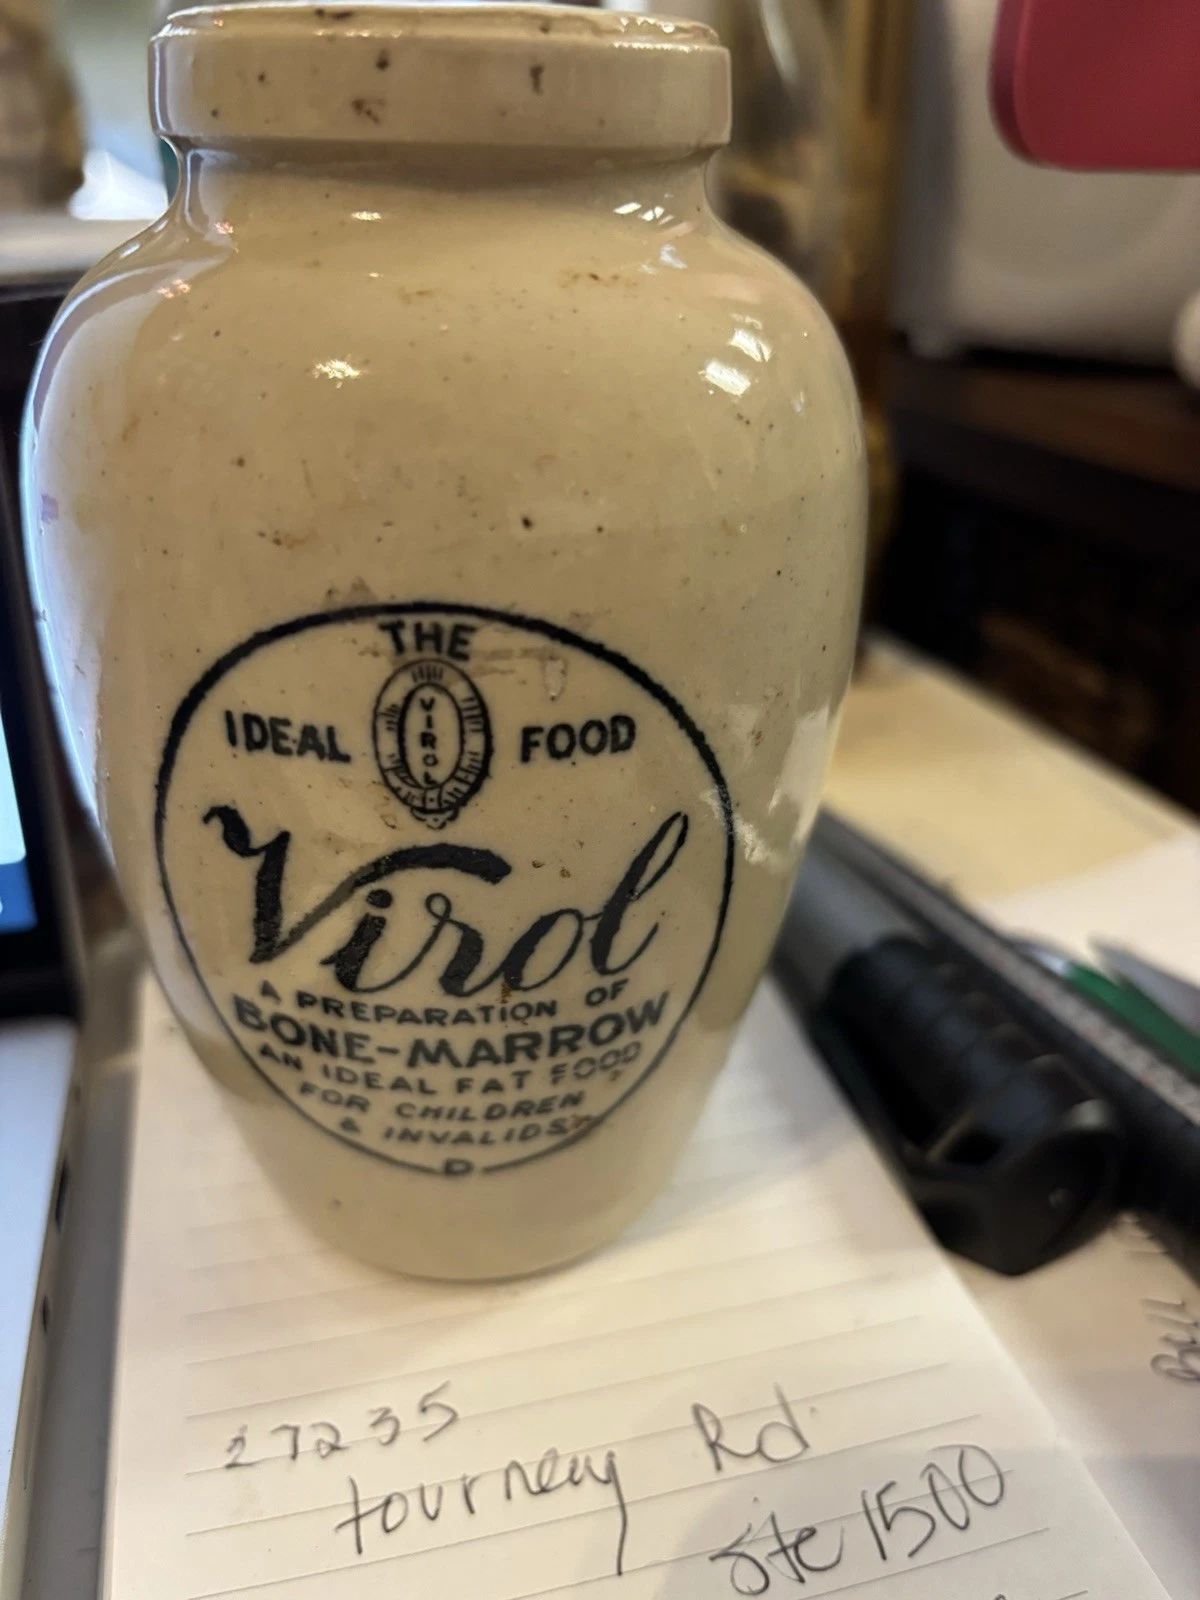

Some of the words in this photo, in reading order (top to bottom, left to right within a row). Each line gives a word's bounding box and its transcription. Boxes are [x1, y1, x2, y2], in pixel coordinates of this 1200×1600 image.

[378, 619, 477, 662] THE
[224, 709, 352, 764] IDEAL
[519, 713, 637, 764] FOOD
[419, 696, 440, 786] VIROL
[202, 805, 689, 999] Virol
[259, 979, 284, 1002] A
[295, 989, 558, 1026] PREPARATION
[584, 977, 630, 1007] OF
[231, 990, 670, 1069] BONE-MARROW
[259, 1043, 303, 1072] AN
[321, 1062, 439, 1095] IDEAL
[456, 1069, 533, 1095] FAT
[550, 1040, 643, 1086] FOOD
[299, 1080, 371, 1114] FOR
[394, 1089, 586, 1122] CHILDREN
[338, 1115, 361, 1138] &
[383, 1115, 570, 1146] INVALIDS
[442, 1157, 475, 1178] D
[224, 1379, 460, 1470] 27235
[859, 1443, 1006, 1561] 1500
